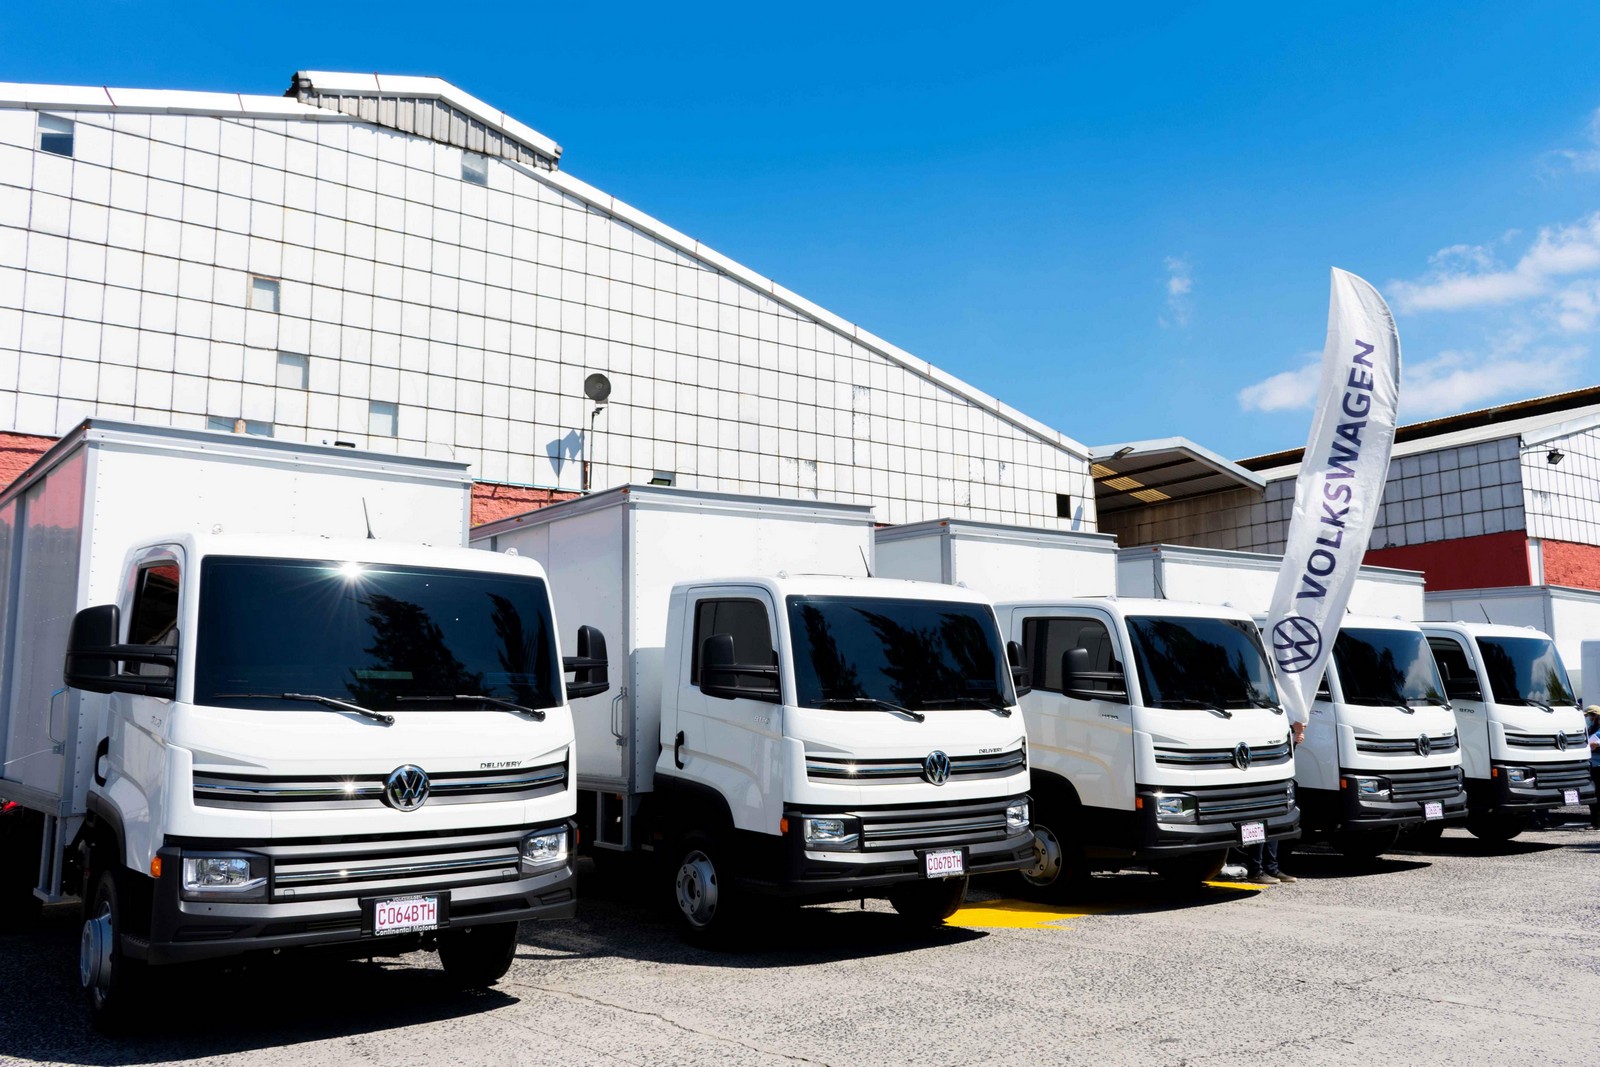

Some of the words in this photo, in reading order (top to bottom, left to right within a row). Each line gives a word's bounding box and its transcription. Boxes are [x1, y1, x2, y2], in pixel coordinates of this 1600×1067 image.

[1296, 339, 1375, 599] VOLKSWAGEN
[480, 761, 522, 769] DELIVERY
[927, 856, 962, 870] C067BTH
[378, 903, 436, 925] C064BTH
[375, 926, 411, 936] Continental
[412, 925, 438, 933] Motores
